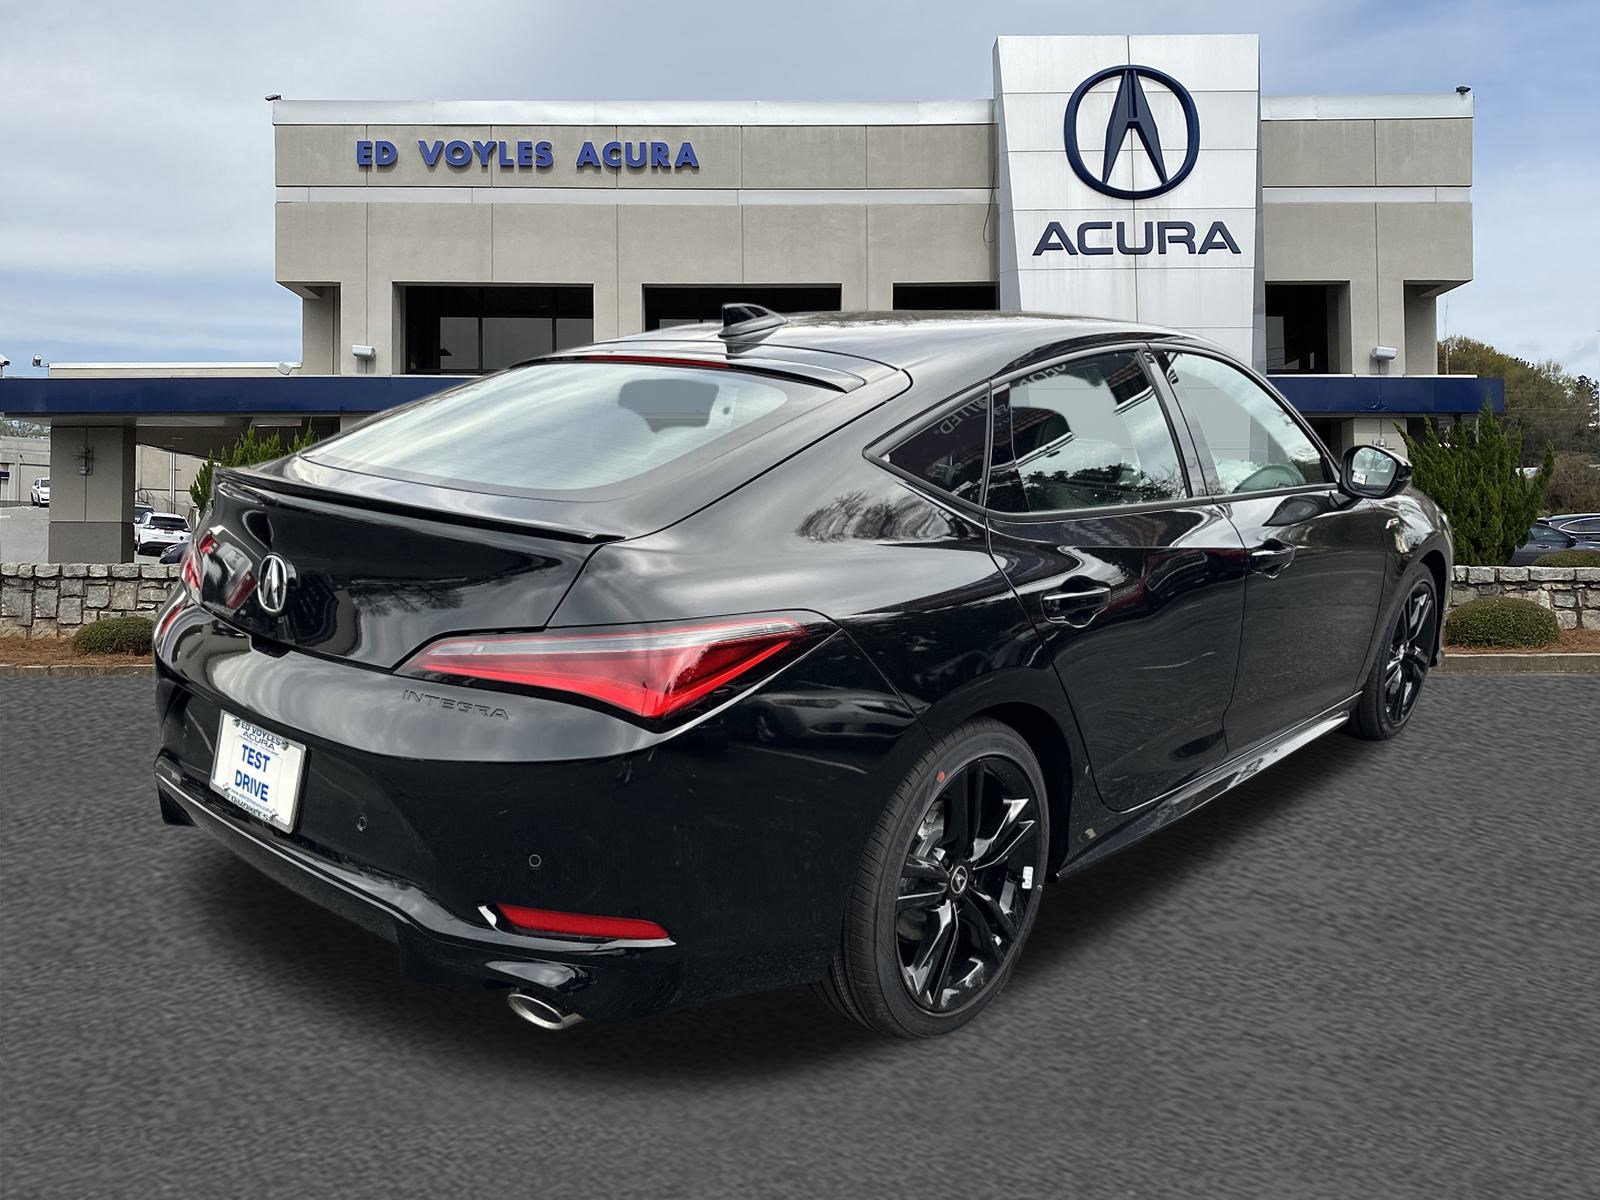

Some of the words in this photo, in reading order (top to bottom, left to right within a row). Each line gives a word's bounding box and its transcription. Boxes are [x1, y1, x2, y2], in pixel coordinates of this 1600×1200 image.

[356, 140, 398, 167] ED
[418, 140, 554, 168] VOYLES
[576, 141, 700, 168] ACURA
[1032, 221, 1242, 256] ACURA
[401, 689, 509, 720] INTEGRA
[241, 721, 251, 731] ED
[252, 725, 280, 746] VOYLES
[242, 731, 275, 751] ACURA
[241, 744, 271, 773] TEST
[234, 769, 270, 802] DRIVE
